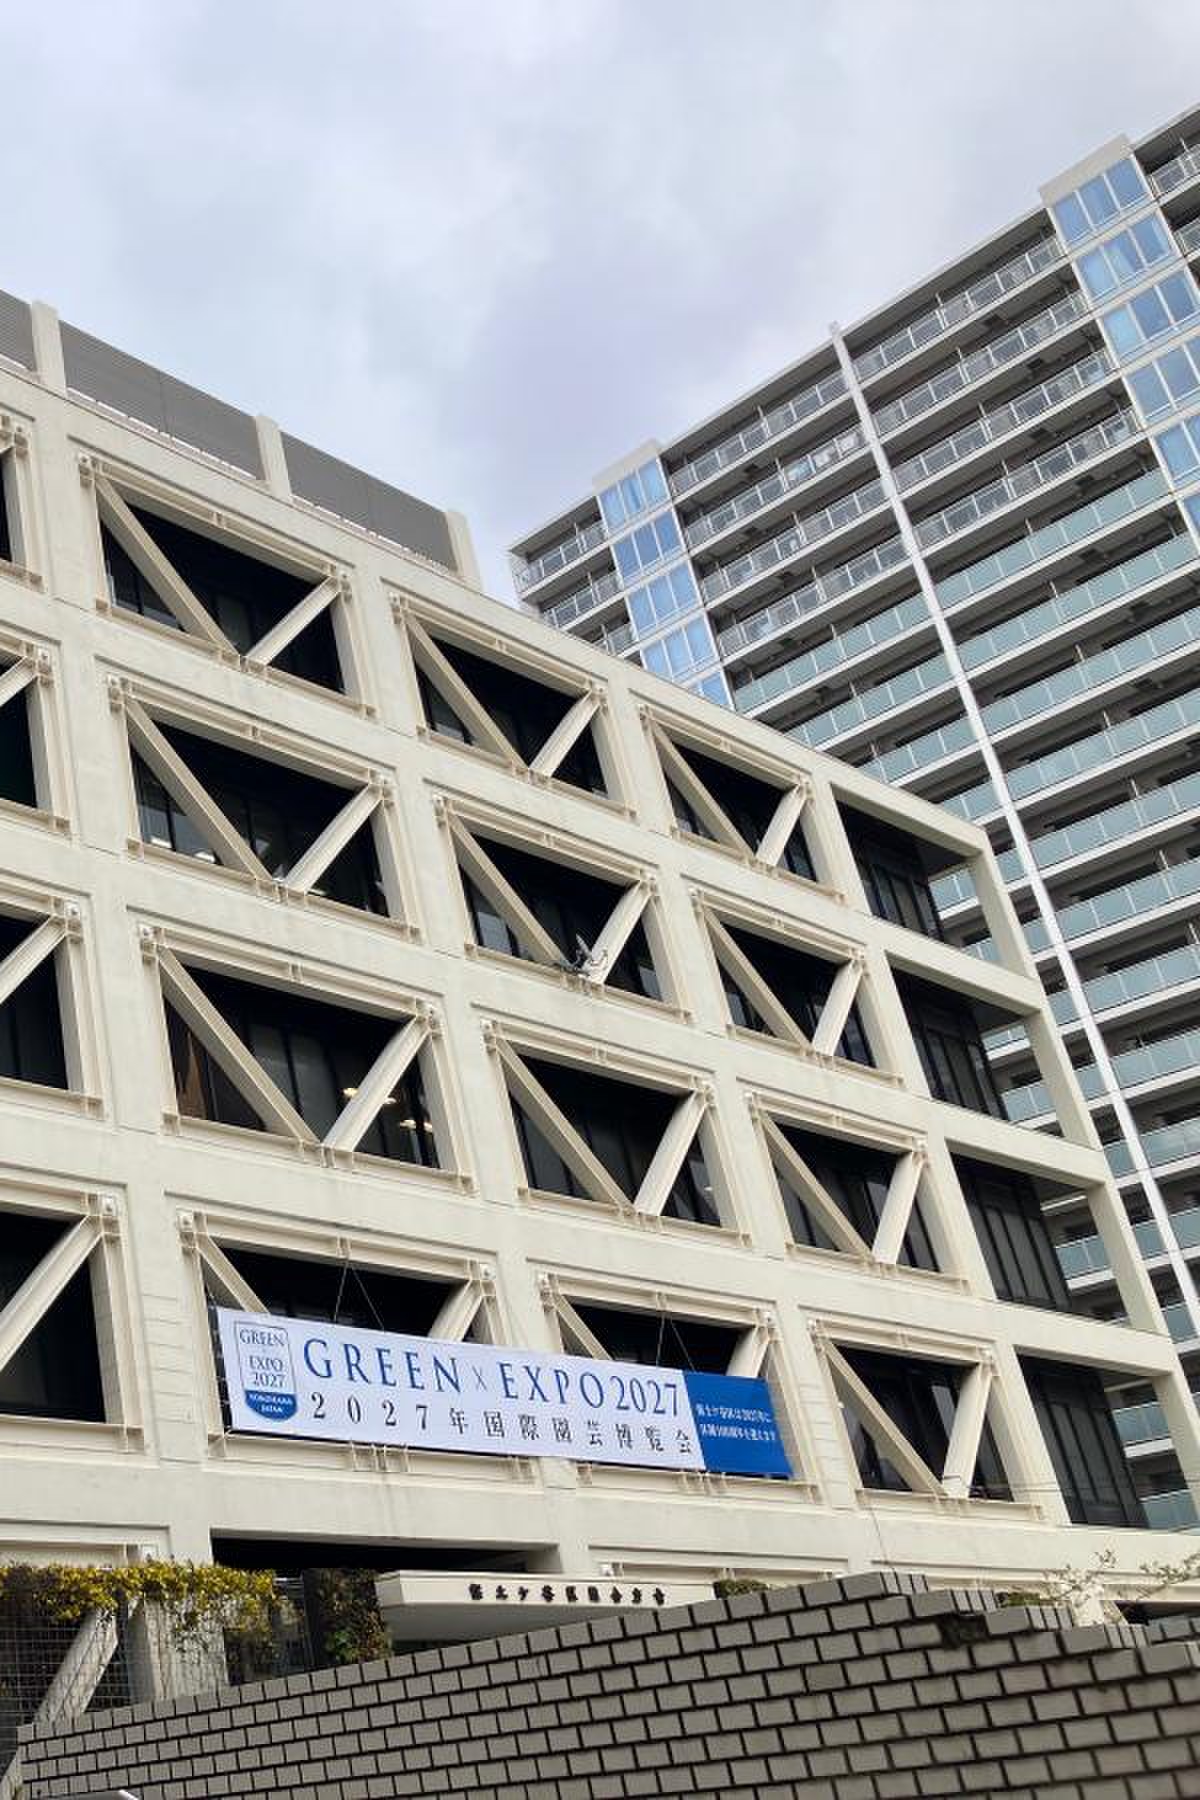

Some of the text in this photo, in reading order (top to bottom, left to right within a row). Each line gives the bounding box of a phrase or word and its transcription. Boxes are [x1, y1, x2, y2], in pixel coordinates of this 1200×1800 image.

[240, 1329, 286, 1346] GREEN
[248, 1355, 284, 1373] EXPO
[303, 1338, 461, 1393] GREEN
[251, 1371, 286, 1388] 2027
[311, 1391, 692, 1454] 2027年国際園芸博覧会
